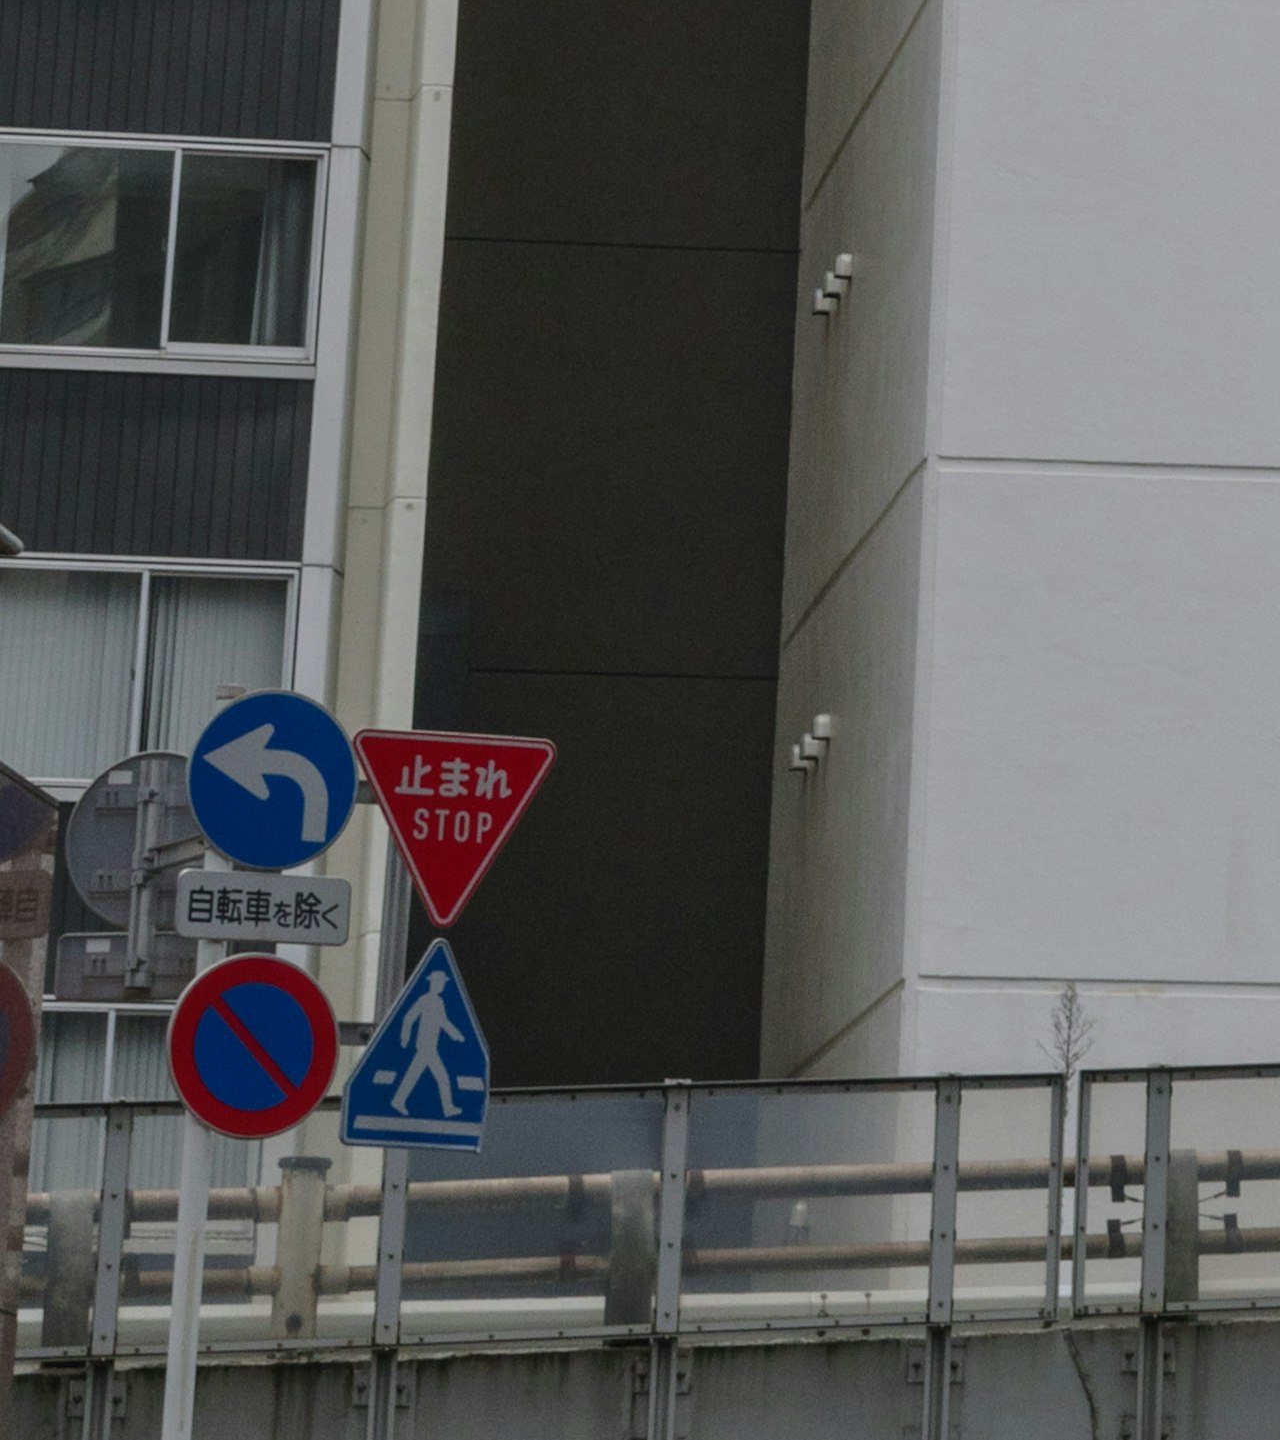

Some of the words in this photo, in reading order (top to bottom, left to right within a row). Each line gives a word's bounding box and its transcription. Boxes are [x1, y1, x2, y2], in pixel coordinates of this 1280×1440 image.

[394, 755, 512, 801] 止まれ
[411, 808, 493, 843] STOP
[187, 887, 340, 931] 自転車を除く
